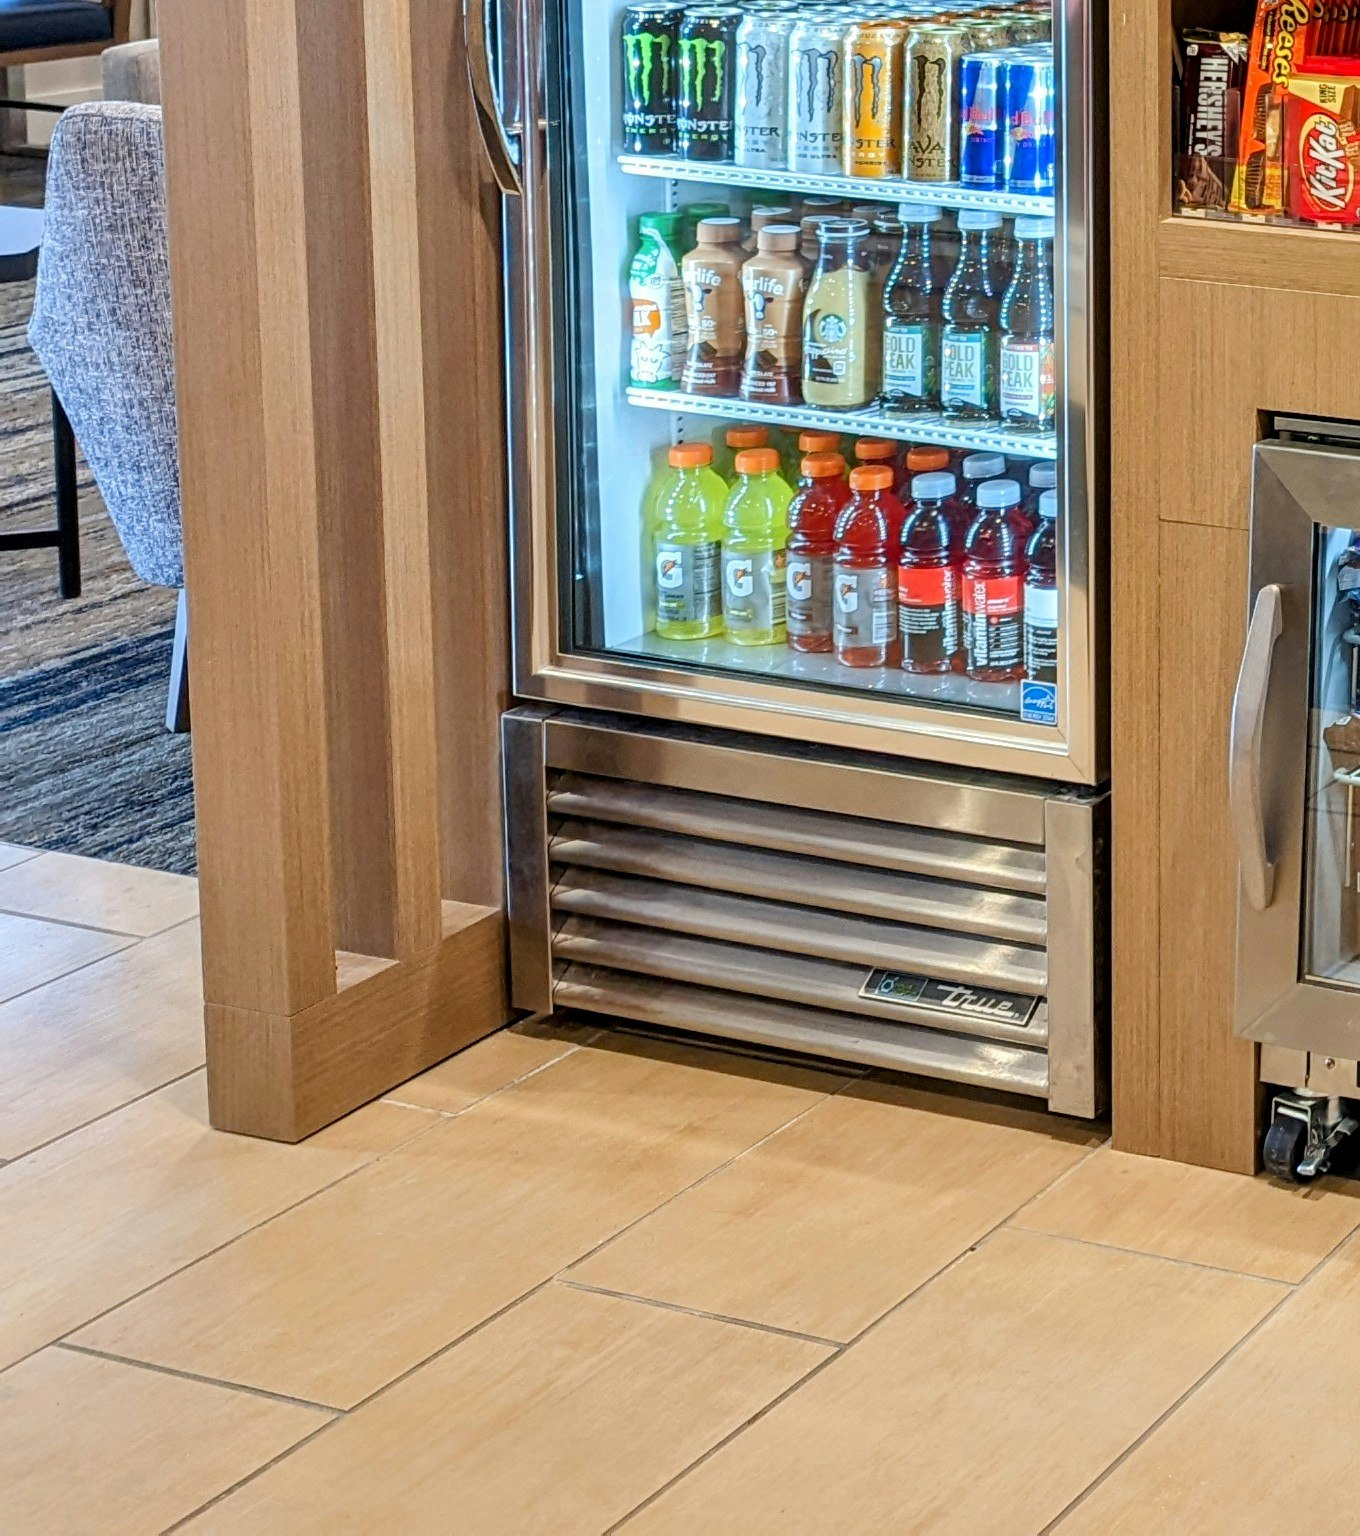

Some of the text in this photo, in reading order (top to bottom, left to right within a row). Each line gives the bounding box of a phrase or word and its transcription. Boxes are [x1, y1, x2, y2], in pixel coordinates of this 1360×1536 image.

[1309, 120, 1347, 208] KitKat
[656, 550, 683, 588] G
[726, 558, 754, 597] G
[786, 561, 813, 600] G
[835, 573, 859, 613] G
